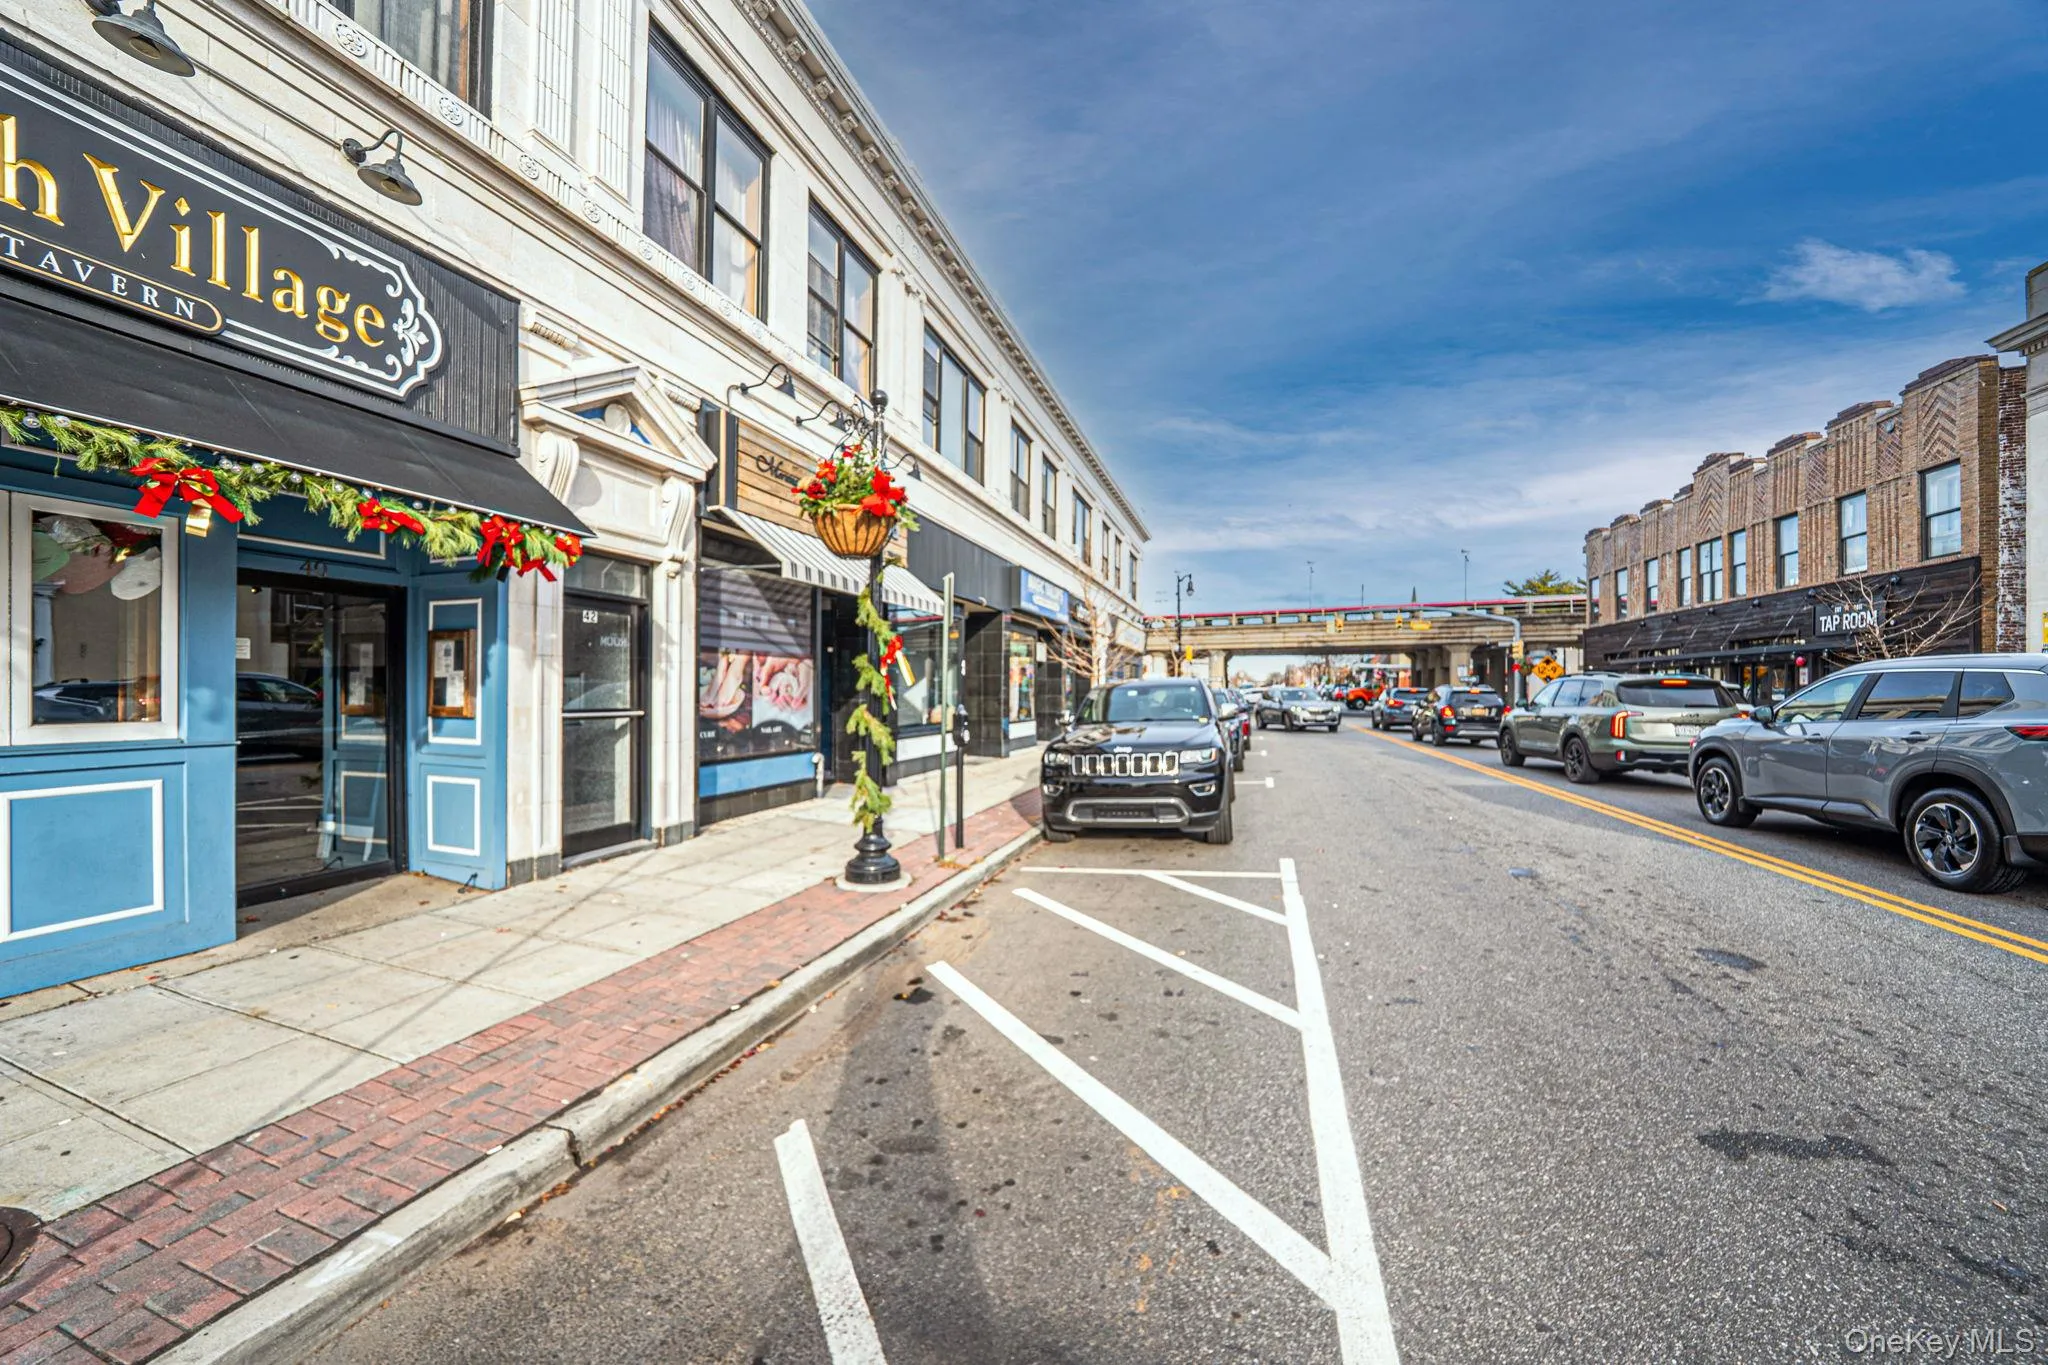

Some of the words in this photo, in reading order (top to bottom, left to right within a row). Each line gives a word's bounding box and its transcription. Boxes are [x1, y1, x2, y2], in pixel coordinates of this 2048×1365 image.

[0, 233, 195, 319] TAVERN
[83, 152, 385, 347] Village
[584, 611, 598, 622] 42
[1819, 614, 1840, 632] TAP
[1842, 610, 1878, 630] ROOM
